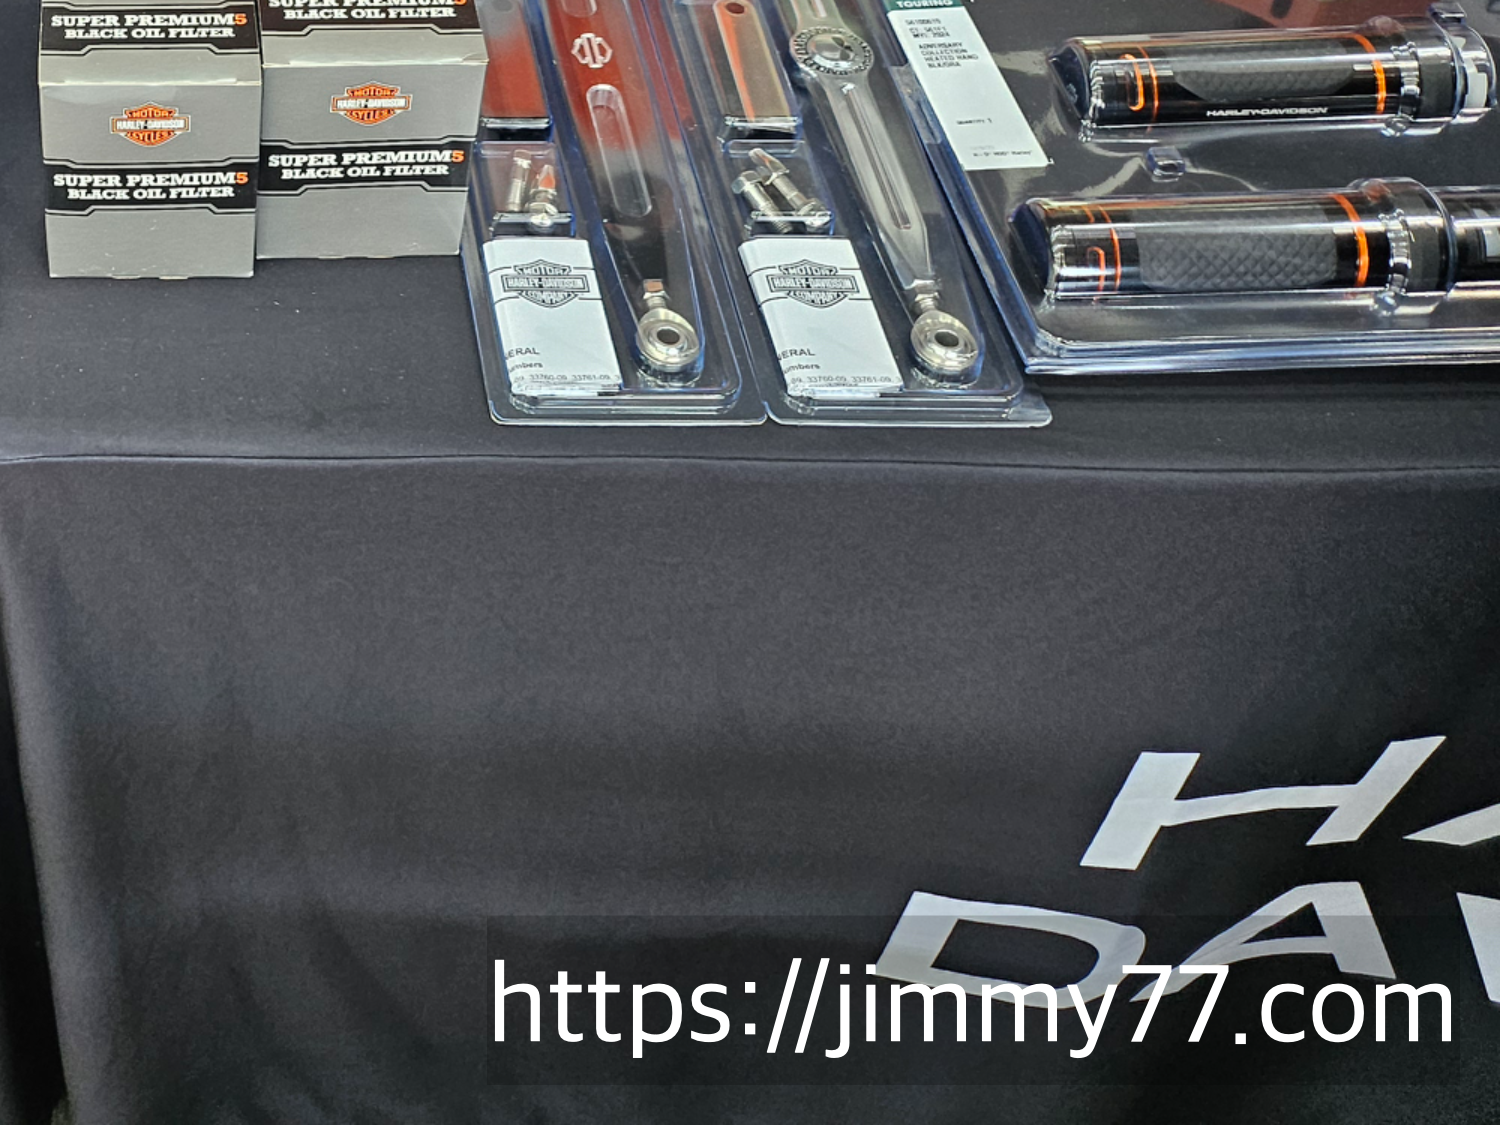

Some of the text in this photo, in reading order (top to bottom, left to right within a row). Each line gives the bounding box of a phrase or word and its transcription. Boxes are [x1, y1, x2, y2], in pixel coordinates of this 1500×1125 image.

[284, 7, 456, 20] BLACK OIL FILTER
[51, 14, 120, 27] SUPER
[64, 27, 235, 39] BLACK OIL FILTER
[1206, 107, 1328, 117] HARLEY-DAVIDSON
[268, 153, 337, 167] SUPER
[281, 165, 450, 180] BLACK OIL FILTER
[53, 173, 122, 187] SUPER
[67, 186, 235, 200] BLACK OIL FILTER
[505, 347, 540, 360] ERAL
[778, 348, 815, 360] ERAL
